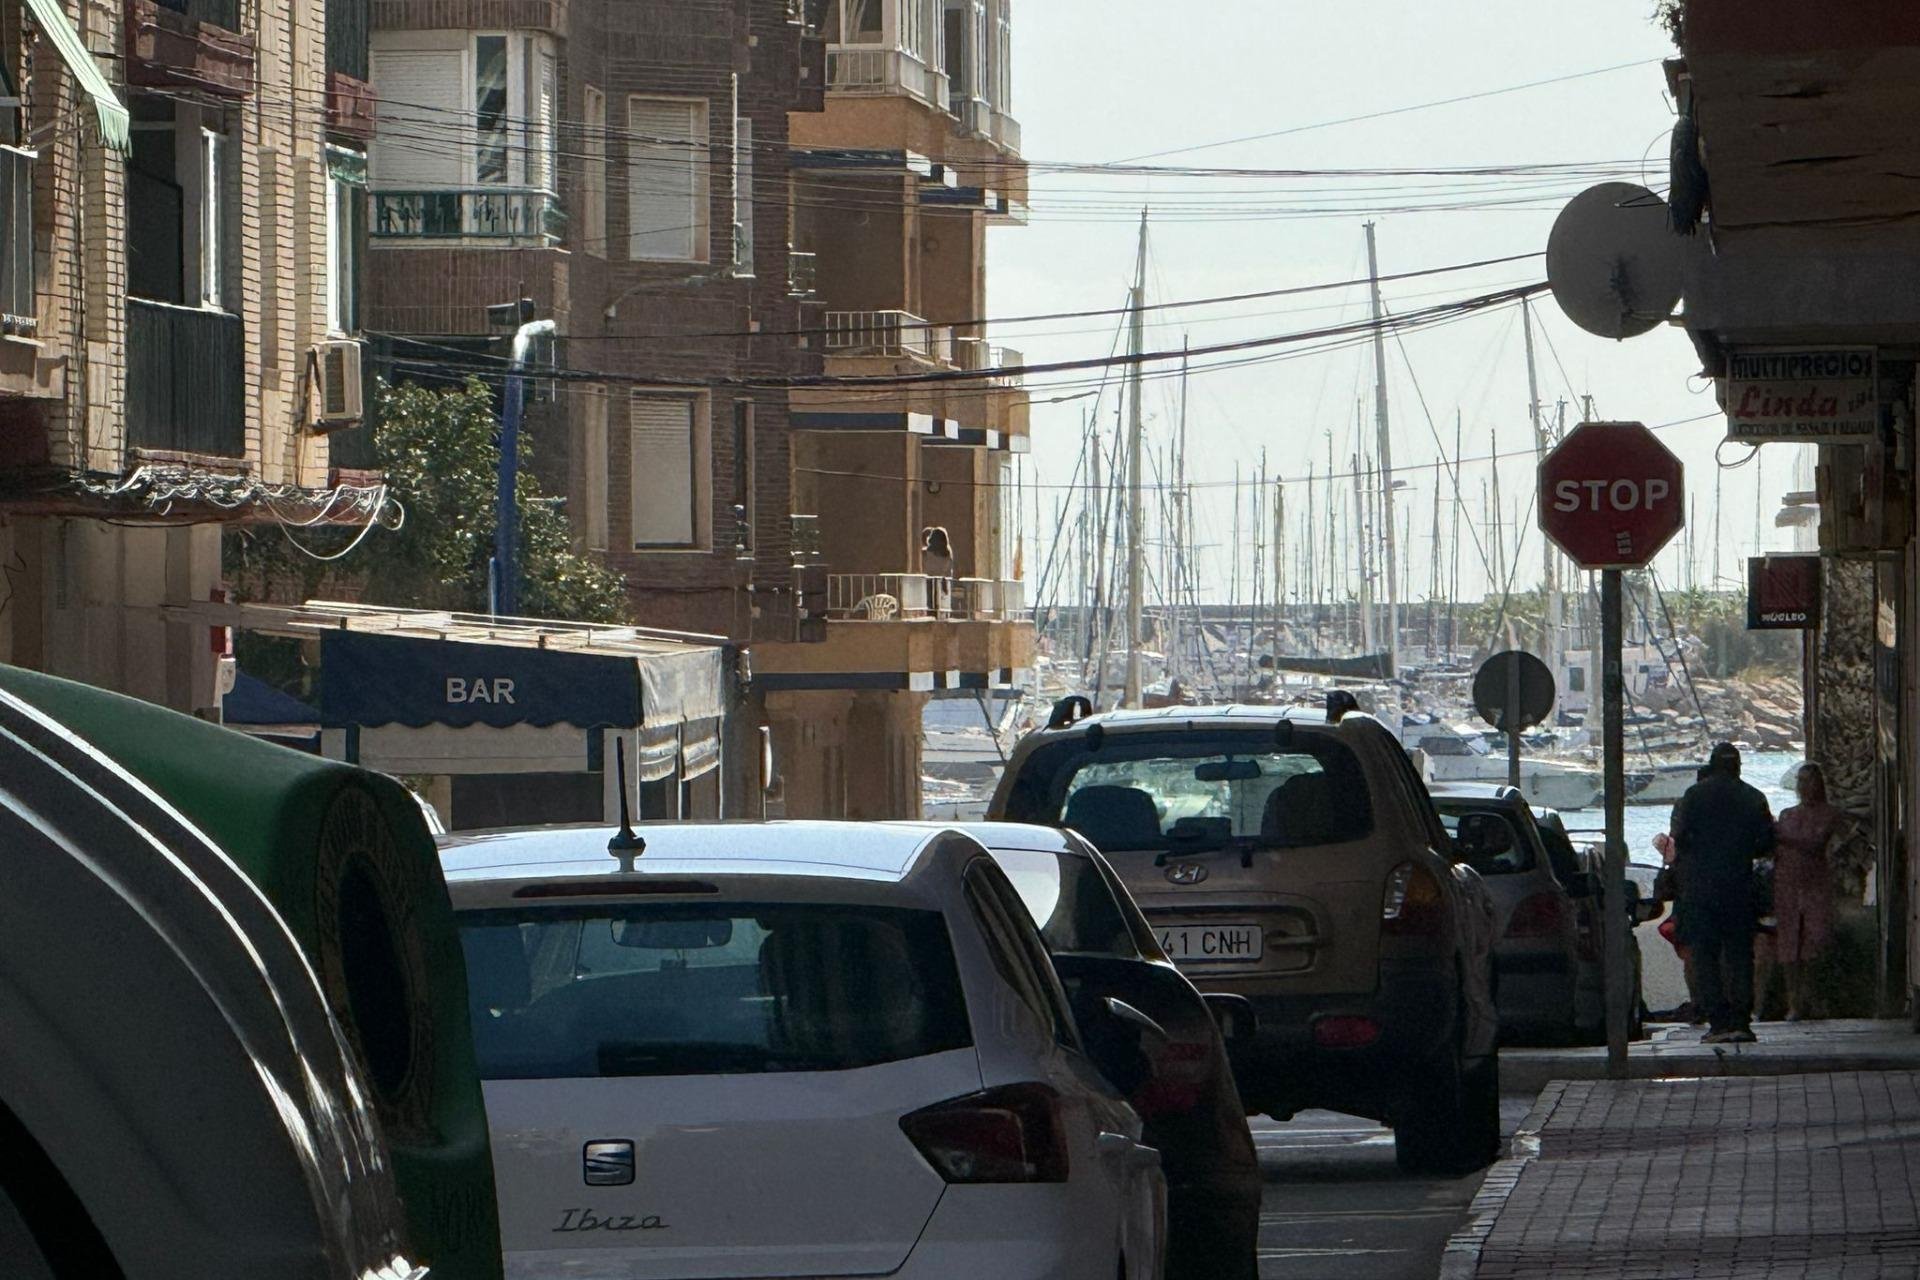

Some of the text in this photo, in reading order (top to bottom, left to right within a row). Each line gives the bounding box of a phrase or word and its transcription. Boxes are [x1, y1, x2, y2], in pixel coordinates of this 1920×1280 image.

[1735, 385, 1837, 416] Linda
[1554, 478, 1669, 512] STOP
[446, 677, 516, 704] BAR
[1202, 931, 1251, 954] CNH
[551, 1208, 671, 1232] Ibiza
